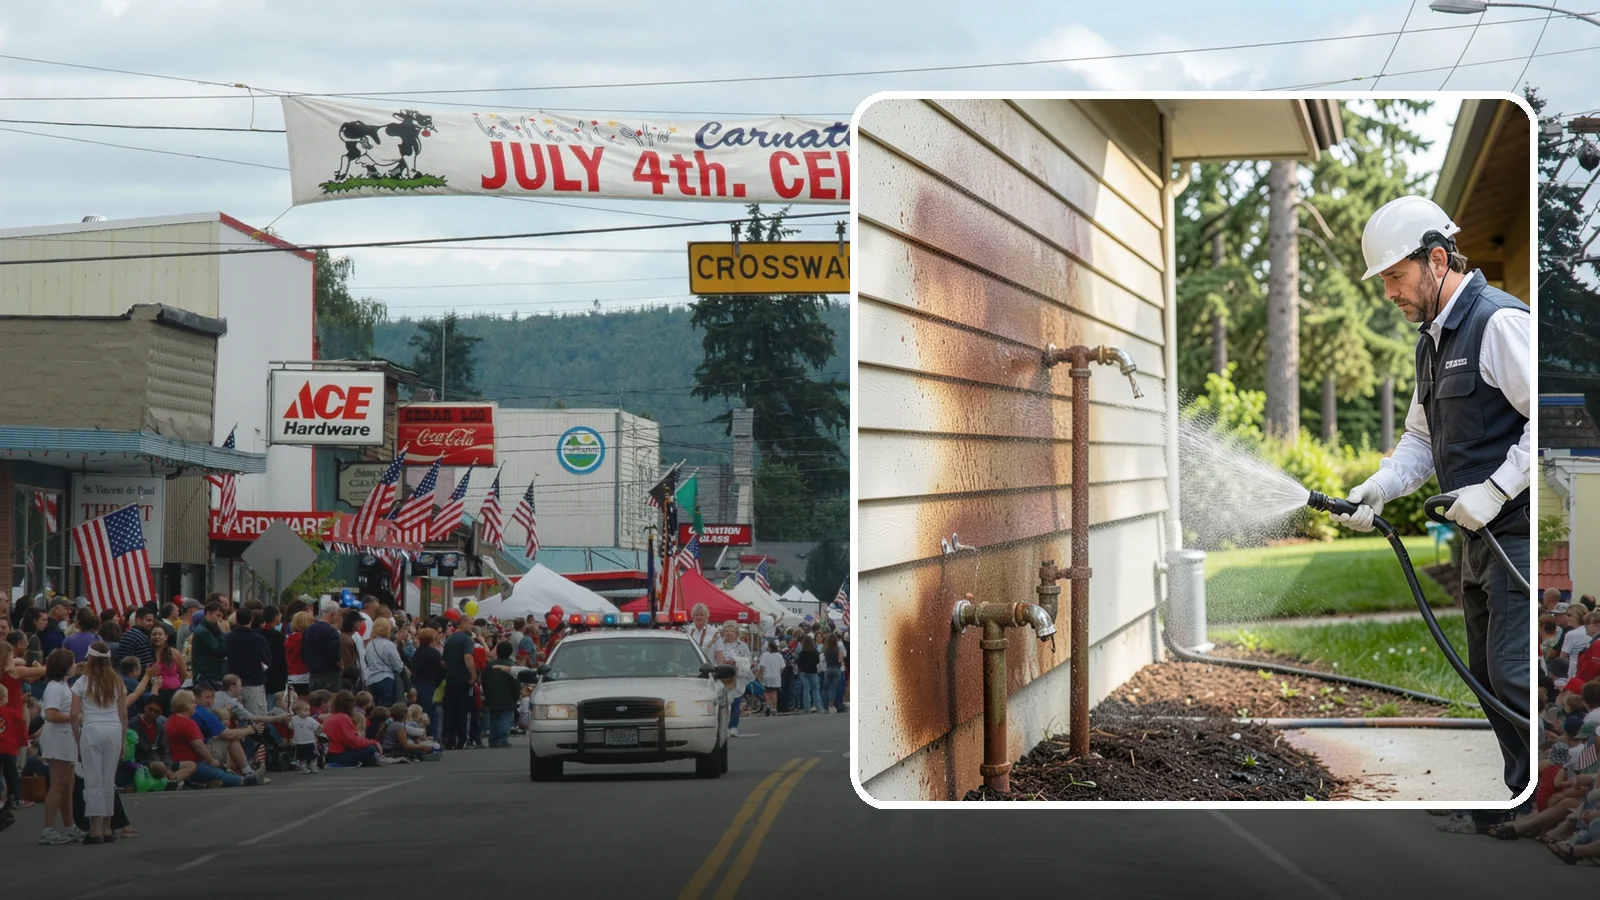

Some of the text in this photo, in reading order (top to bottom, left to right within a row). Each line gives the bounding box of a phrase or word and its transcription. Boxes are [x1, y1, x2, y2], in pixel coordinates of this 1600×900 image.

[481, 141, 604, 193] JULY
[632, 150, 746, 198] 4th.
[697, 254, 850, 280] CROSSWA
[282, 380, 373, 420] ACE
[406, 410, 452, 421] CEDAR
[283, 421, 370, 436] Hardware
[416, 428, 477, 447] Coca-Cola
[83, 485, 155, 495] St. Vincent de Paul
[688, 526, 741, 535] CRNATION
